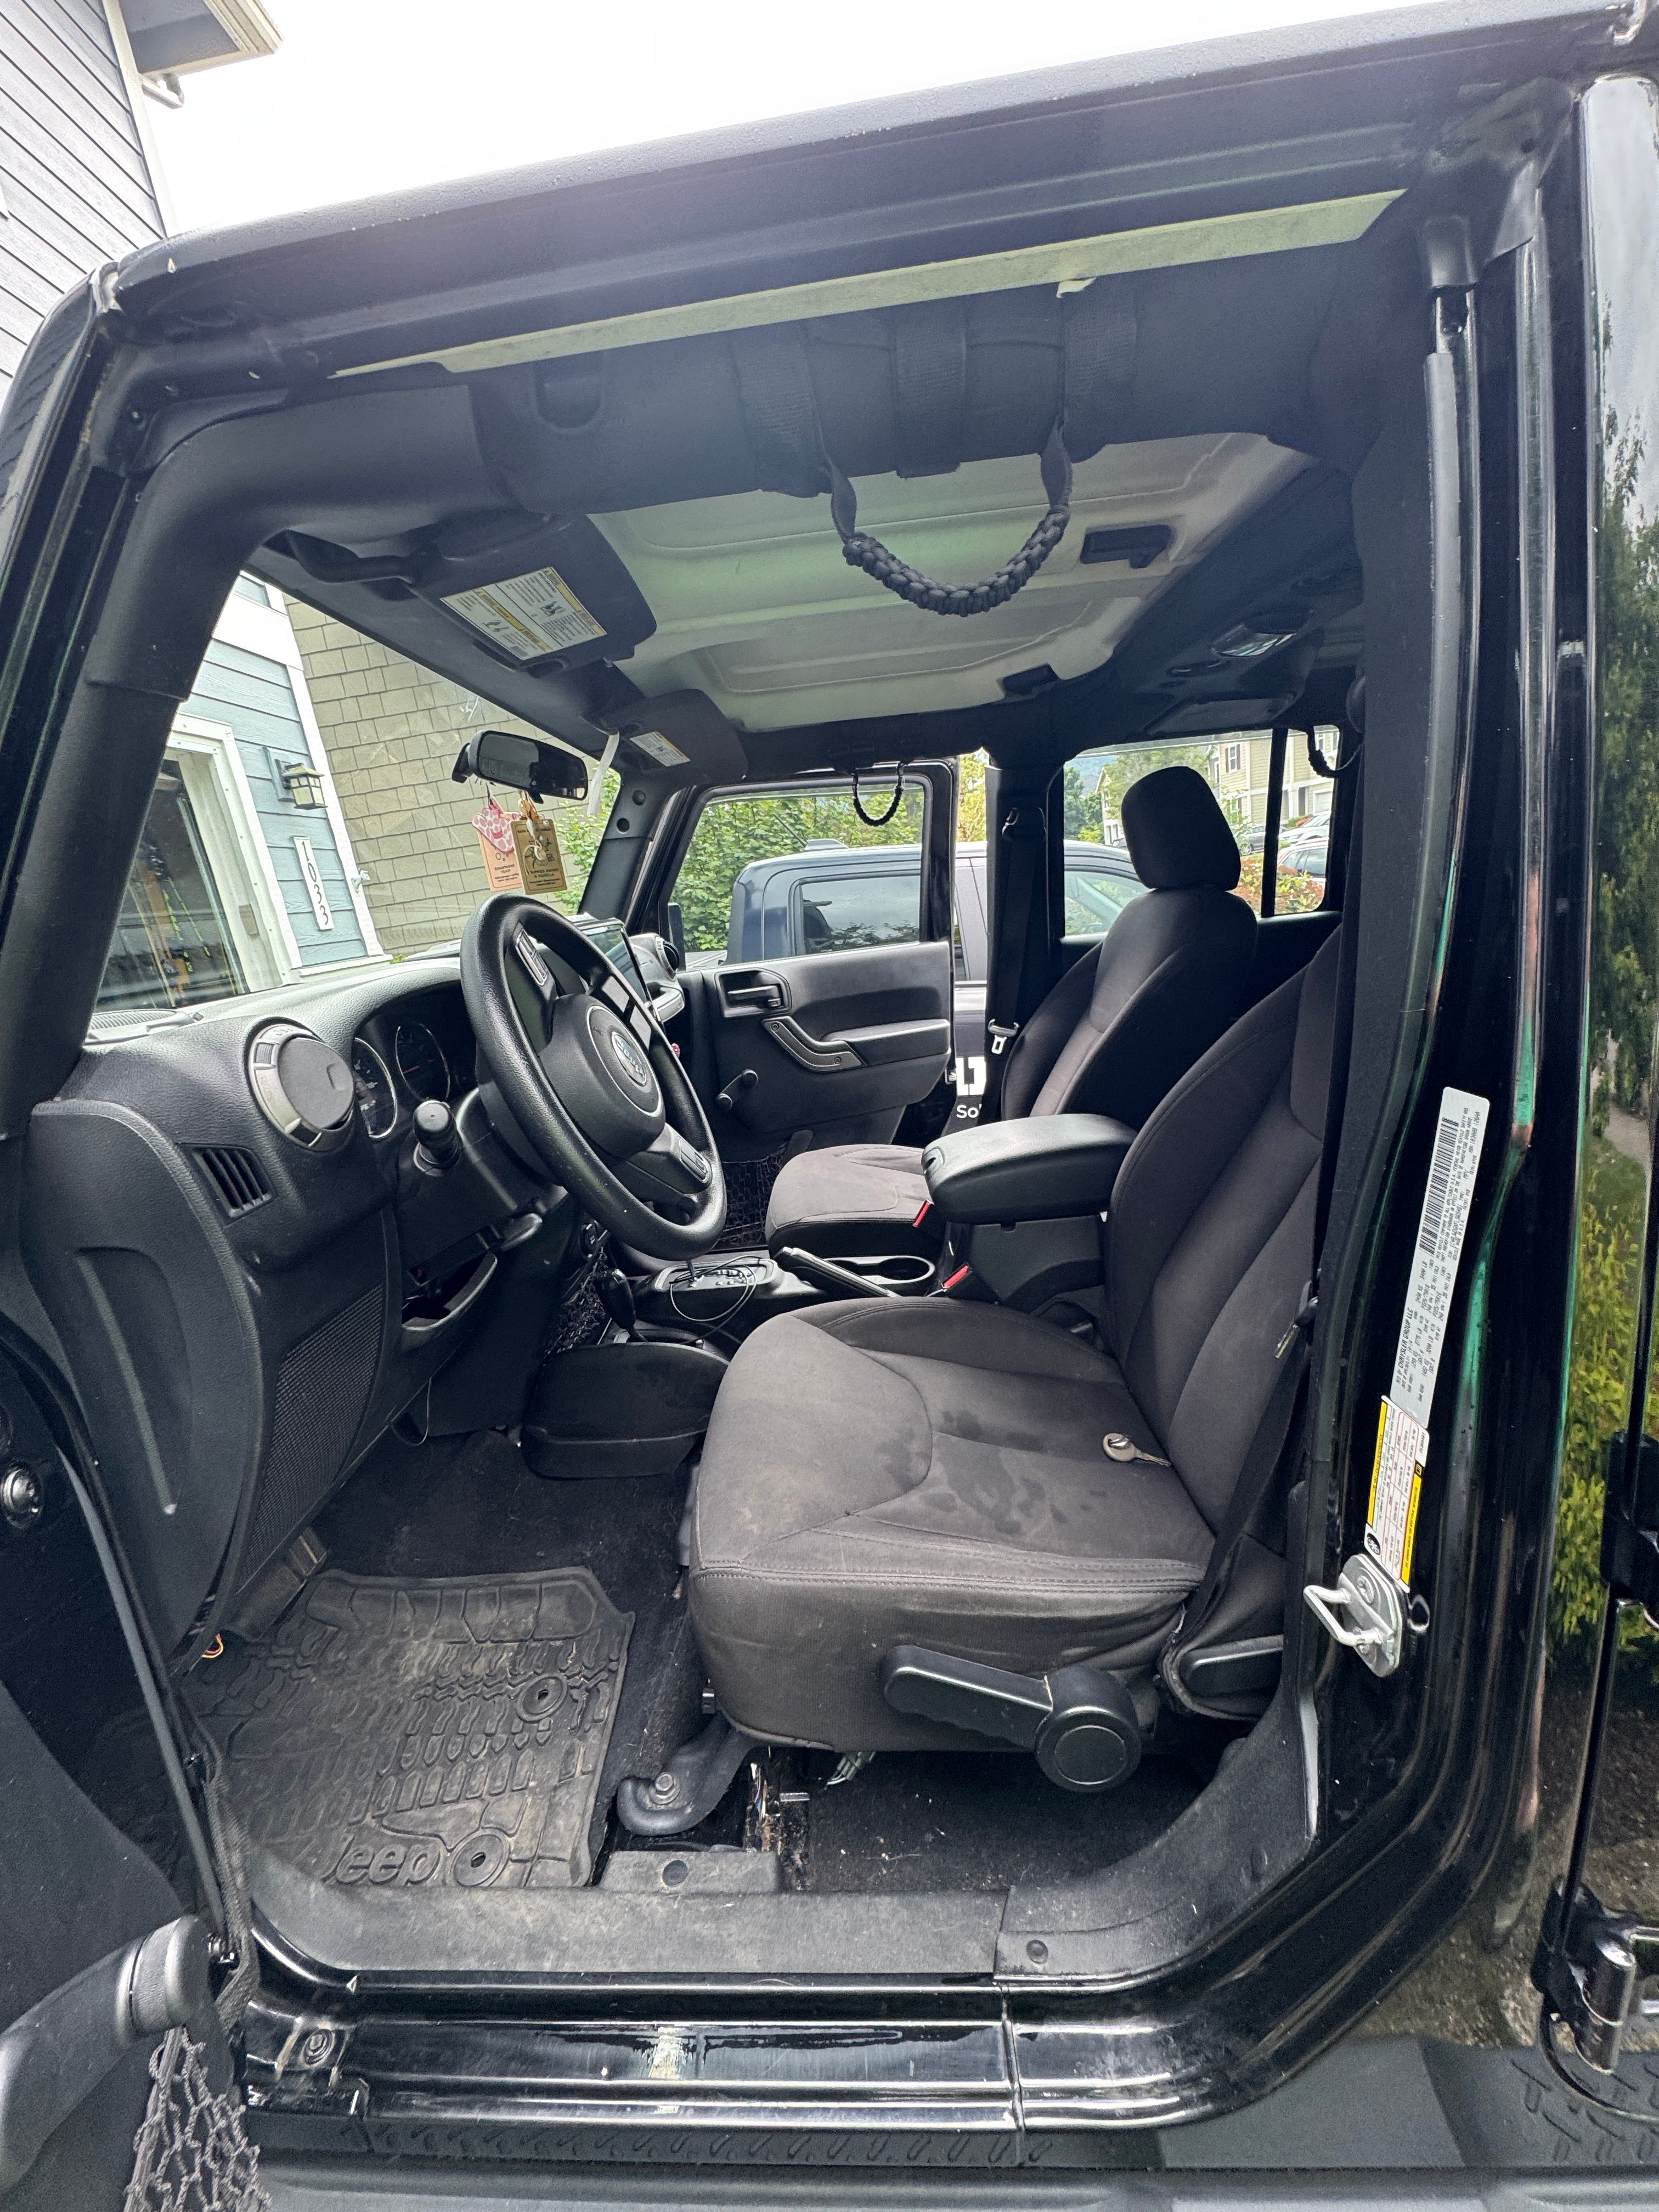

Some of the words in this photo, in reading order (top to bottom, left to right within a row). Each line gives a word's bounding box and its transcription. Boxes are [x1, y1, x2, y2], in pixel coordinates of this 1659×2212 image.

[301, 841, 329, 926] 1033
[1397, 1338, 1407, 1369] CHRYSLER
[1402, 1318, 1411, 1340] GROUP
[320, 1832, 442, 1887] Jeep
